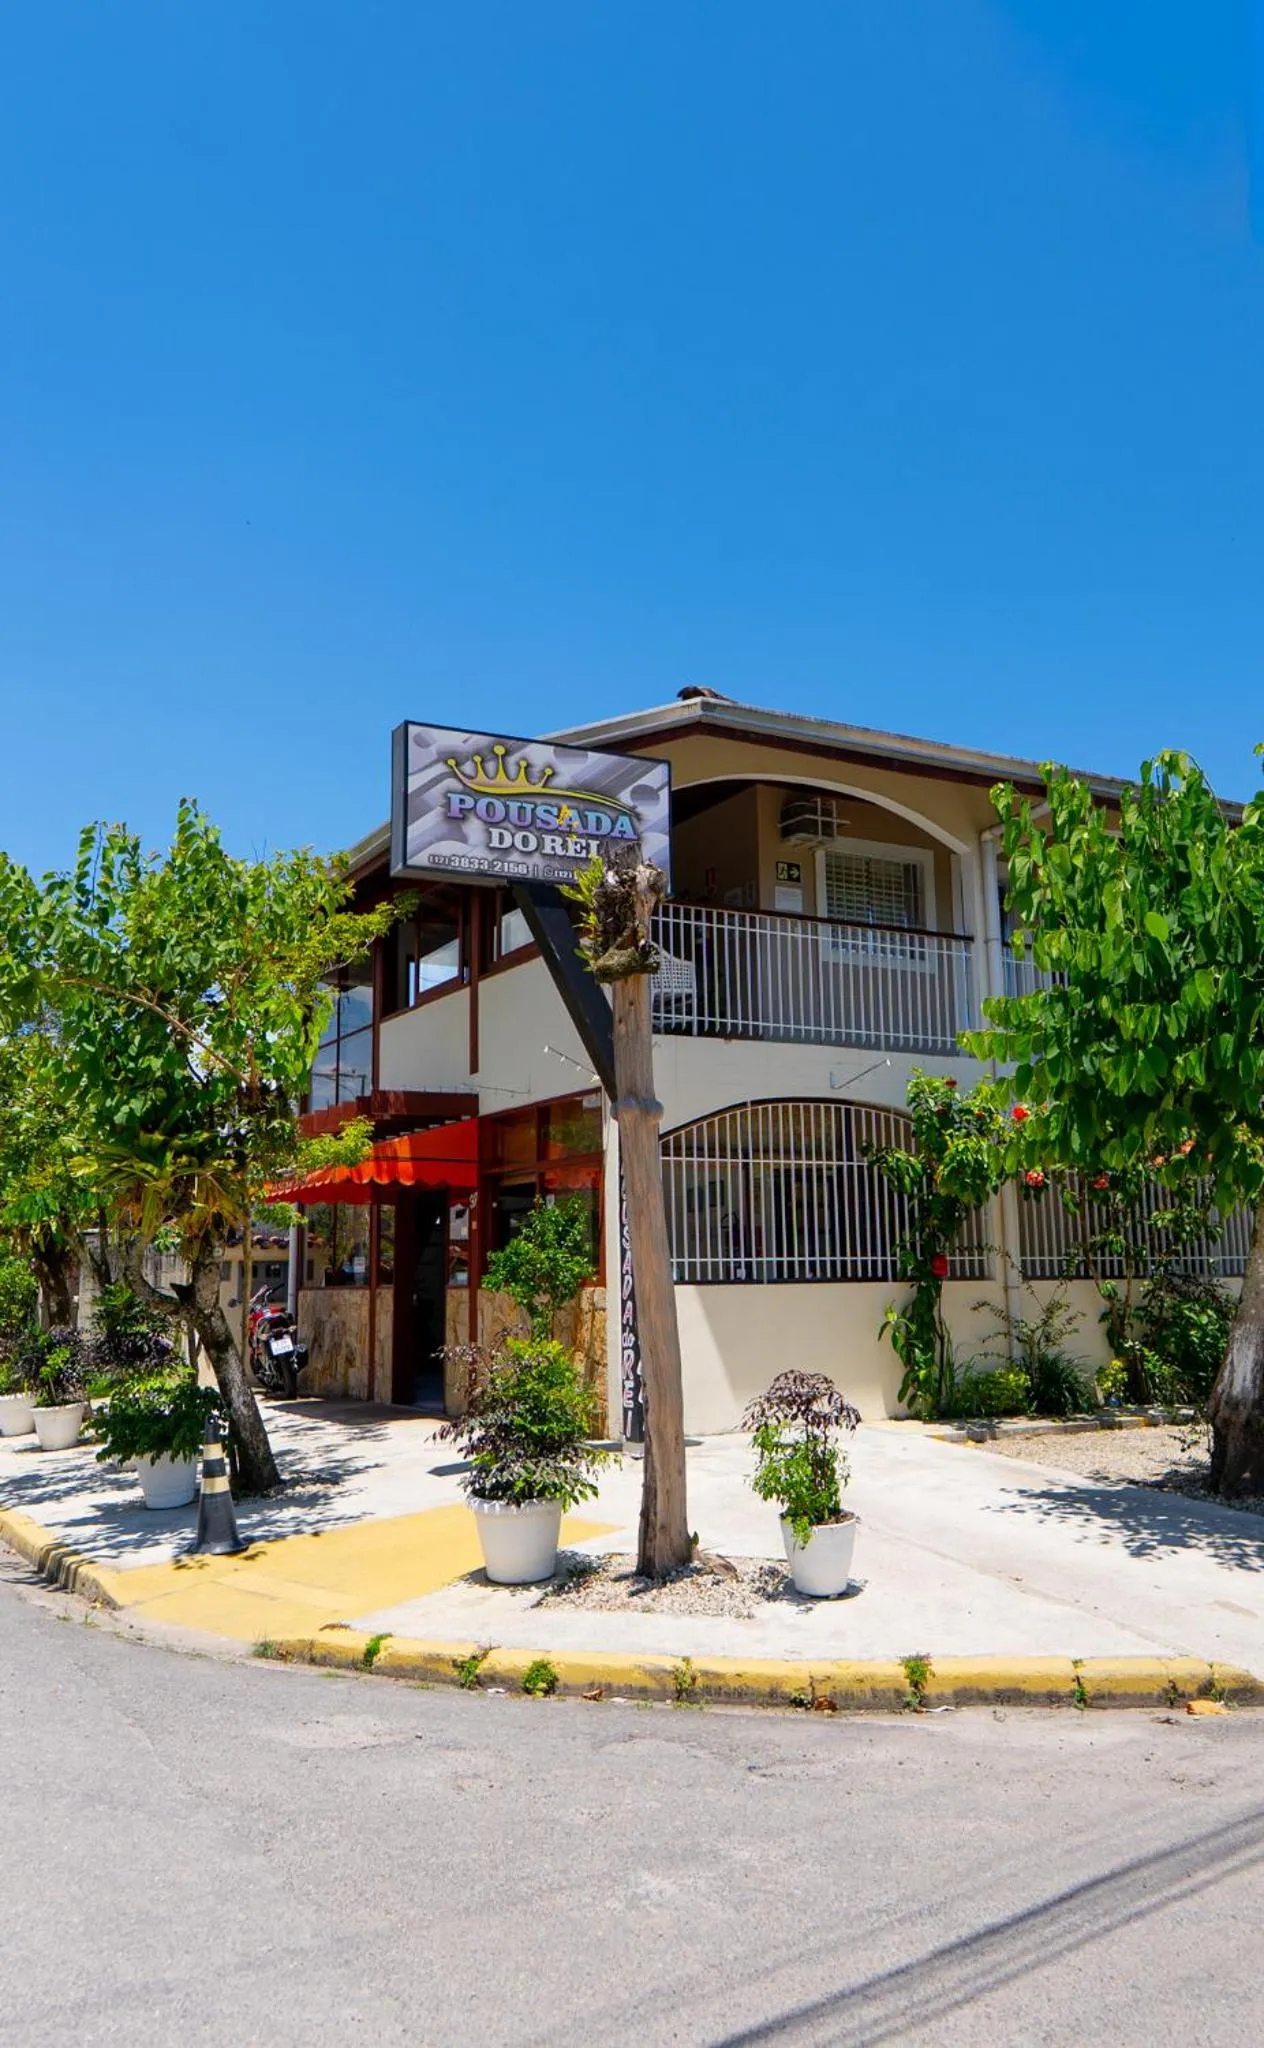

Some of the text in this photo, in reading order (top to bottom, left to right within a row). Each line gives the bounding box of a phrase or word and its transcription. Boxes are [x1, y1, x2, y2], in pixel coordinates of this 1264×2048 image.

[447, 793, 639, 840] POUSADA
[489, 828, 600, 858] DO REI
[622, 1349, 634, 1438] REI
